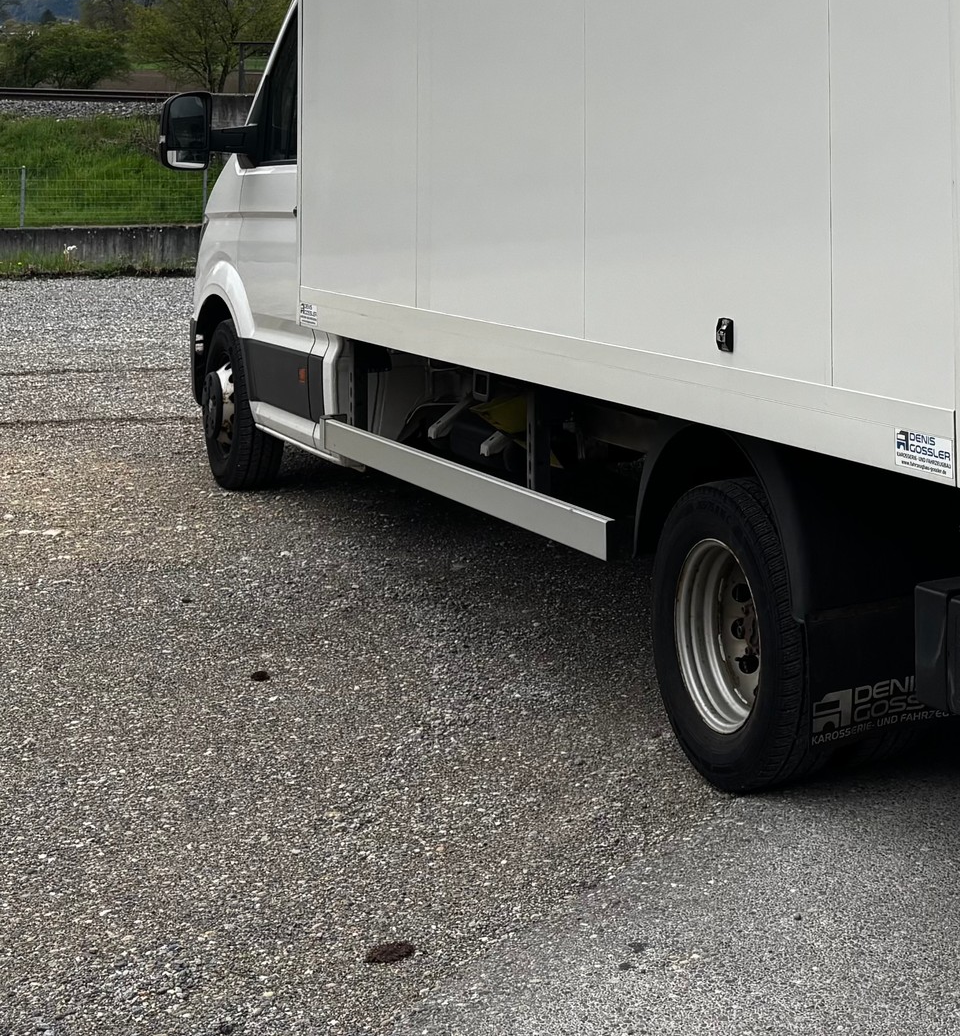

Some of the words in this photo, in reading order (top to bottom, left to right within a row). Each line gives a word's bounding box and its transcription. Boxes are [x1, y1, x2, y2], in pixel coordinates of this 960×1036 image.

[909, 432, 936, 446] DENIS
[909, 443, 951, 462] GOSSLER
[854, 675, 917, 705] DENI
[810, 721, 876, 746] KAROSSERIE-
[876, 714, 899, 728] UND
